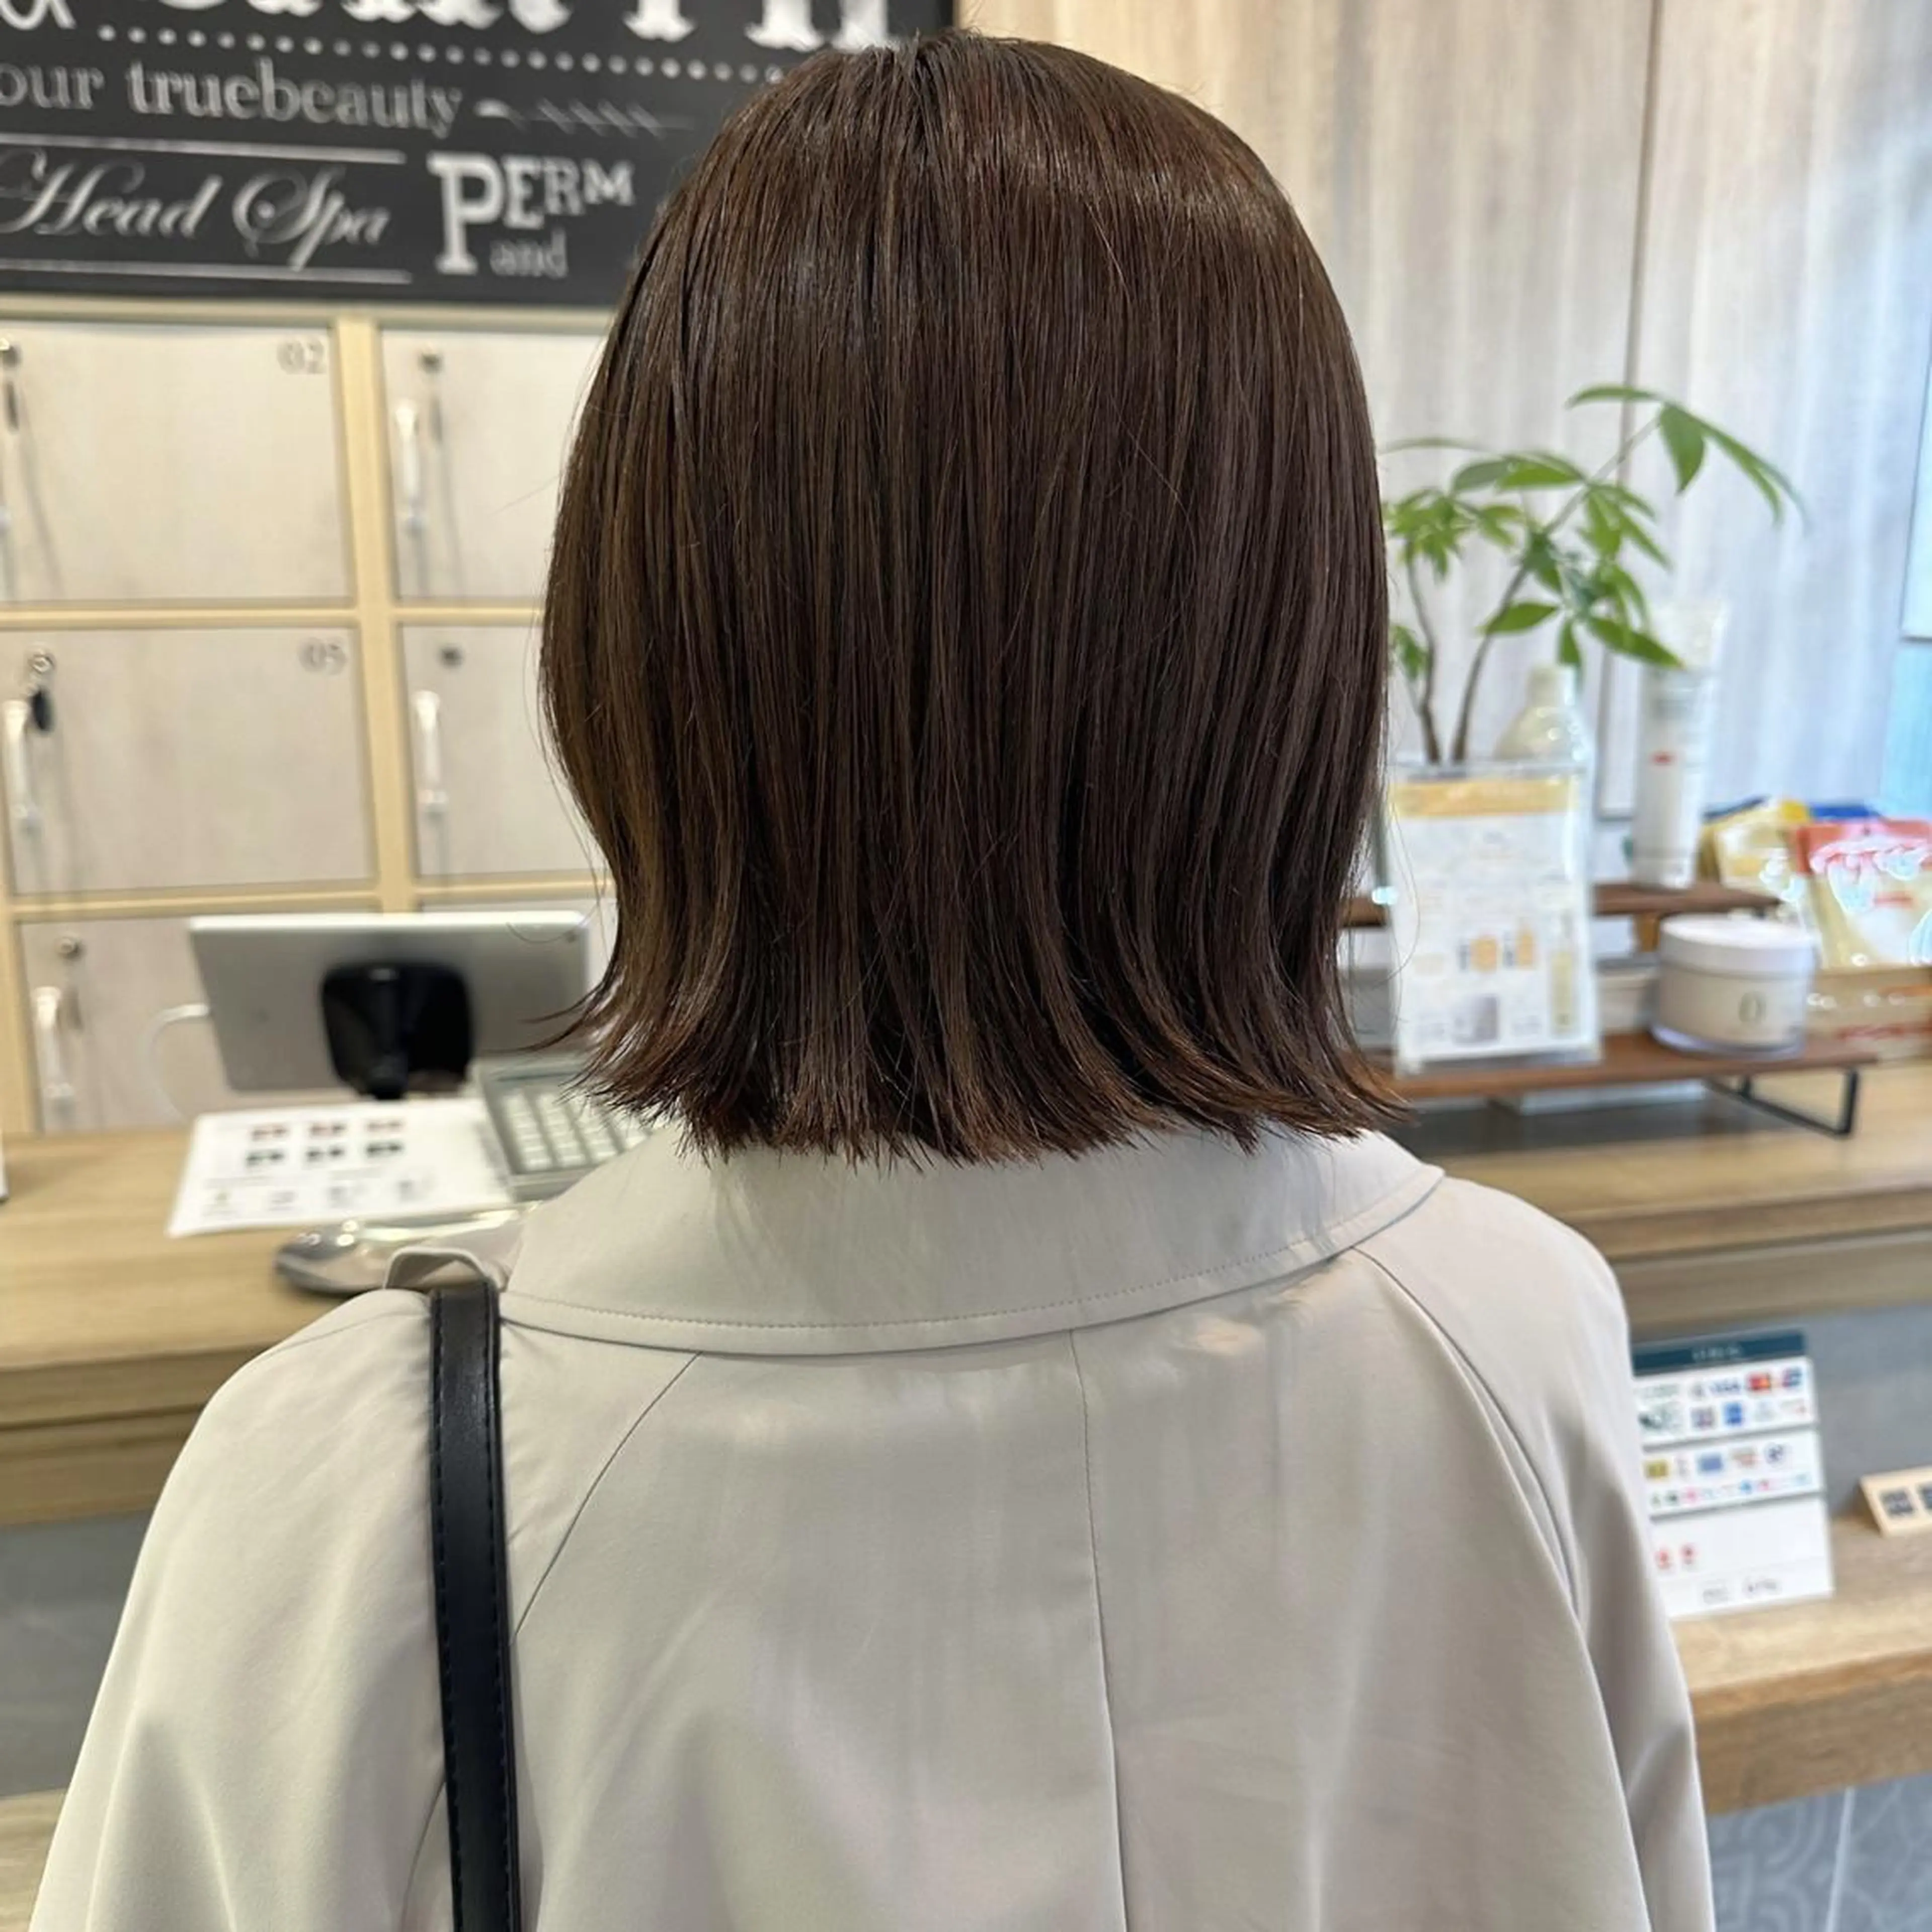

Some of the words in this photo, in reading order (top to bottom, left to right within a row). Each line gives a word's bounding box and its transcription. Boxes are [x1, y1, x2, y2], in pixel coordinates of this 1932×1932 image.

[125, 55, 463, 139] truebeauty
[0, 147, 223, 238] Head
[232, 165, 390, 272] Spa
[427, 151, 635, 276] PERM
[490, 227, 569, 280] and
[277, 338, 327, 375] 02
[298, 636, 347, 675] 05
